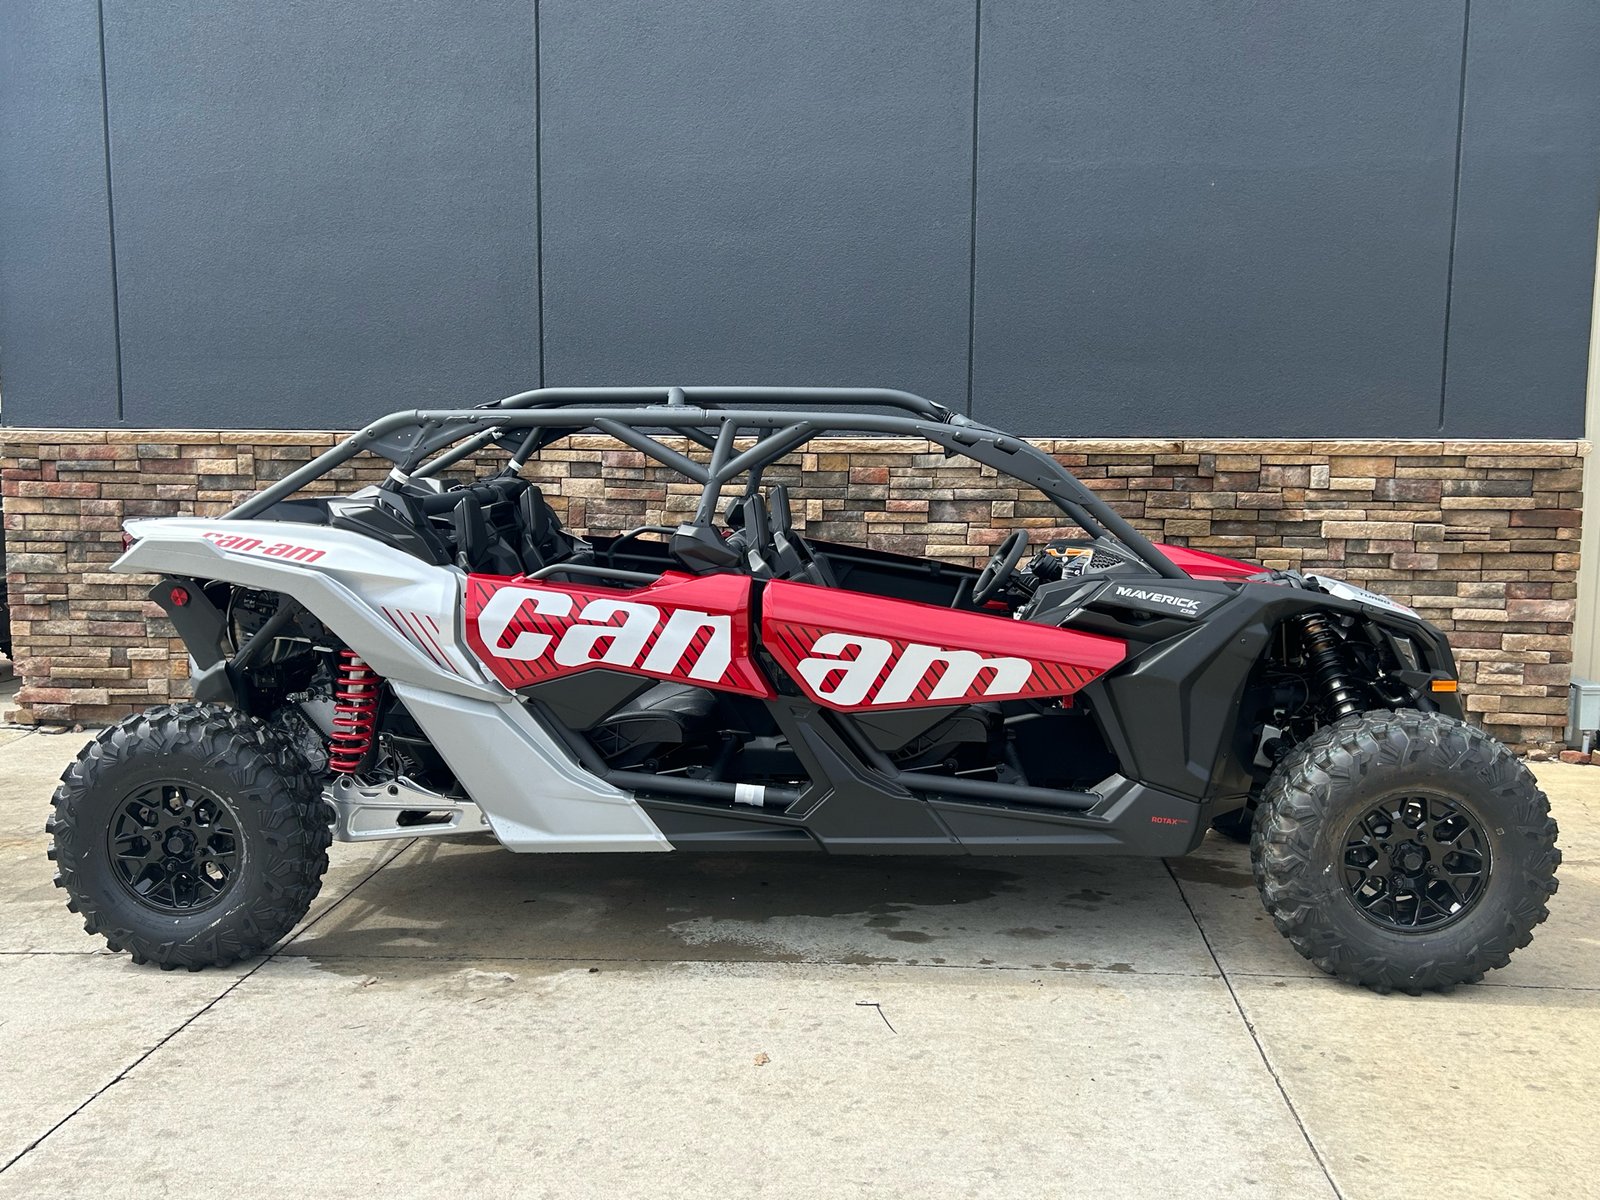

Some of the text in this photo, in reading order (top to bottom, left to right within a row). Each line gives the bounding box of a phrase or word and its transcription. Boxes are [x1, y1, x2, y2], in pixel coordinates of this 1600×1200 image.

[202, 532, 327, 563] can-am
[1115, 586, 1202, 610] MAVERICK
[478, 586, 1033, 706] can am
[1151, 816, 1178, 825] ROTAX
